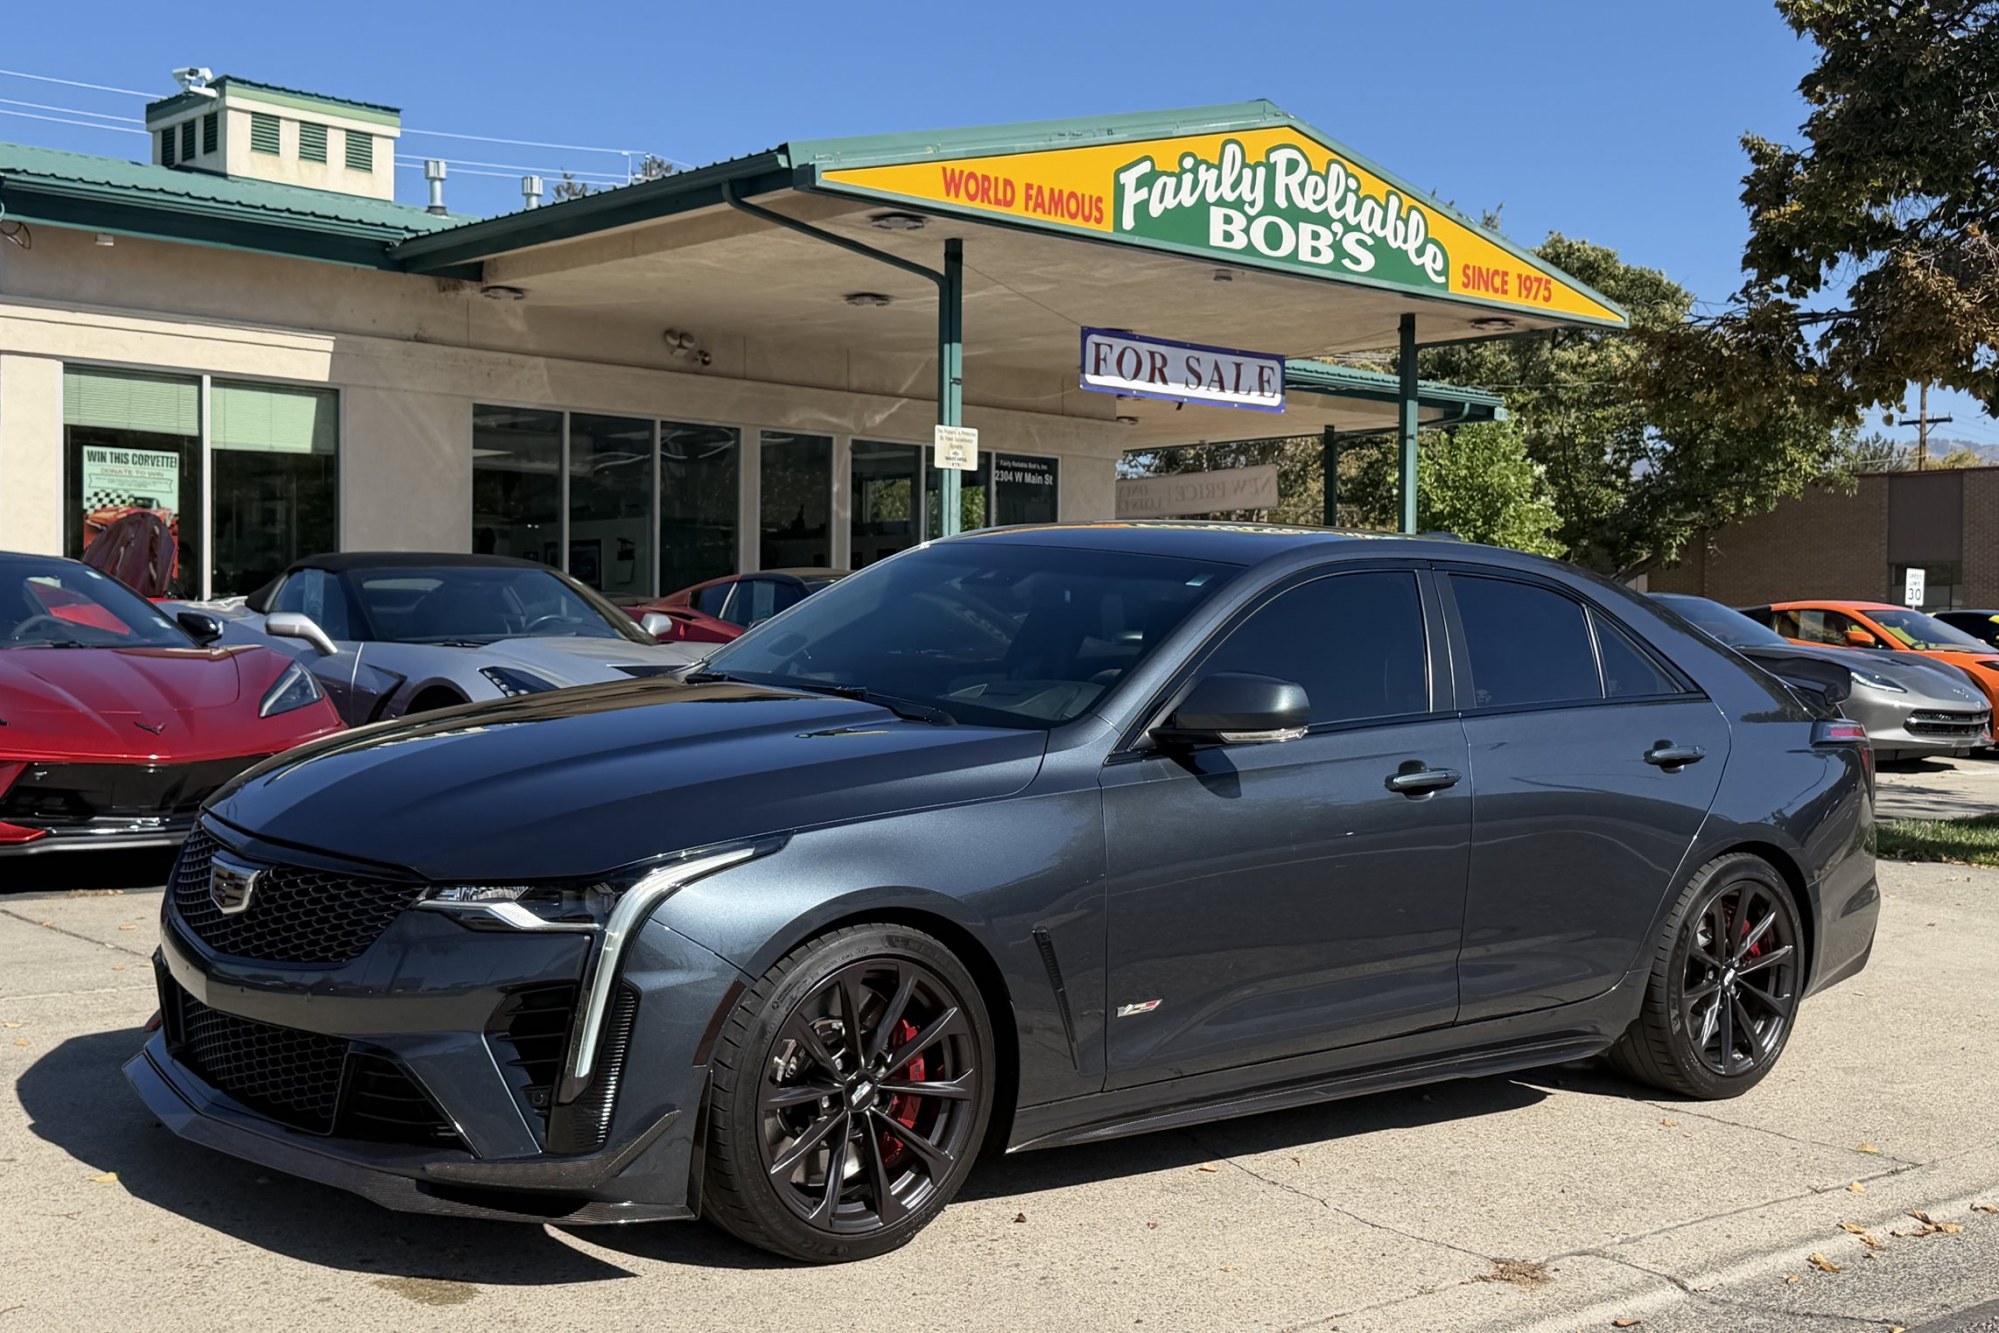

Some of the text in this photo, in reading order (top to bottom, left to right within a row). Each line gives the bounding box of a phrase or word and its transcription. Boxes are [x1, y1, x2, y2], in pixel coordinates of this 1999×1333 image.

[941, 166, 1104, 225] WORLD FAMOUS
[1119, 142, 1446, 284] Fairly Reliable
[1208, 205, 1376, 273] BOB'S
[1461, 263, 1552, 302] SINCE 1975
[1091, 341, 1277, 399] FOR SALE
[87, 450, 177, 468] WIN THIS CORVETTE!
[995, 469, 1053, 486] 2304 W Main St
[1908, 588, 1921, 601] 30
